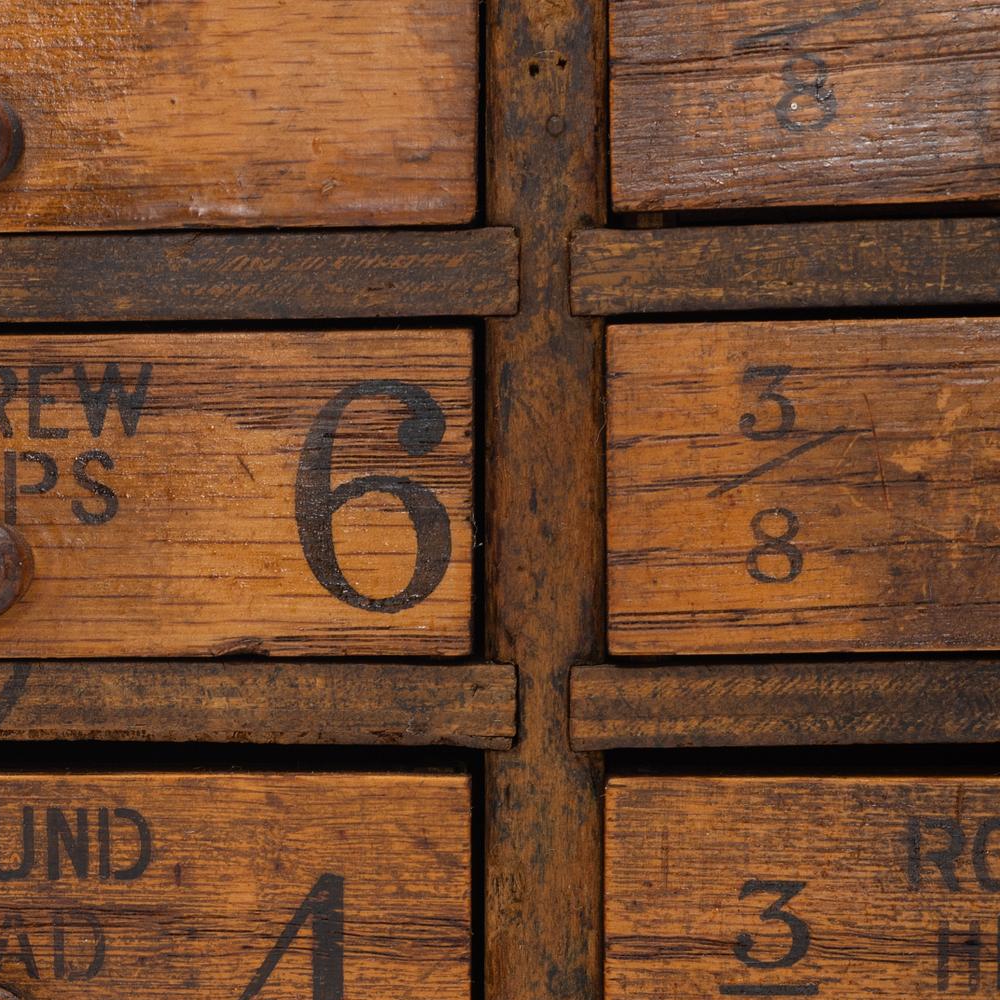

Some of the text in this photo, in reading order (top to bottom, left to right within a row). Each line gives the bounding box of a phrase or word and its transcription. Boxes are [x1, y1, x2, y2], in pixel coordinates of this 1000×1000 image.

[775, 52, 838, 132] 8
[739, 364, 797, 441] 3
[294, 378, 452, 614] 6
[747, 507, 803, 584] 8
[731, 879, 813, 970] 3
